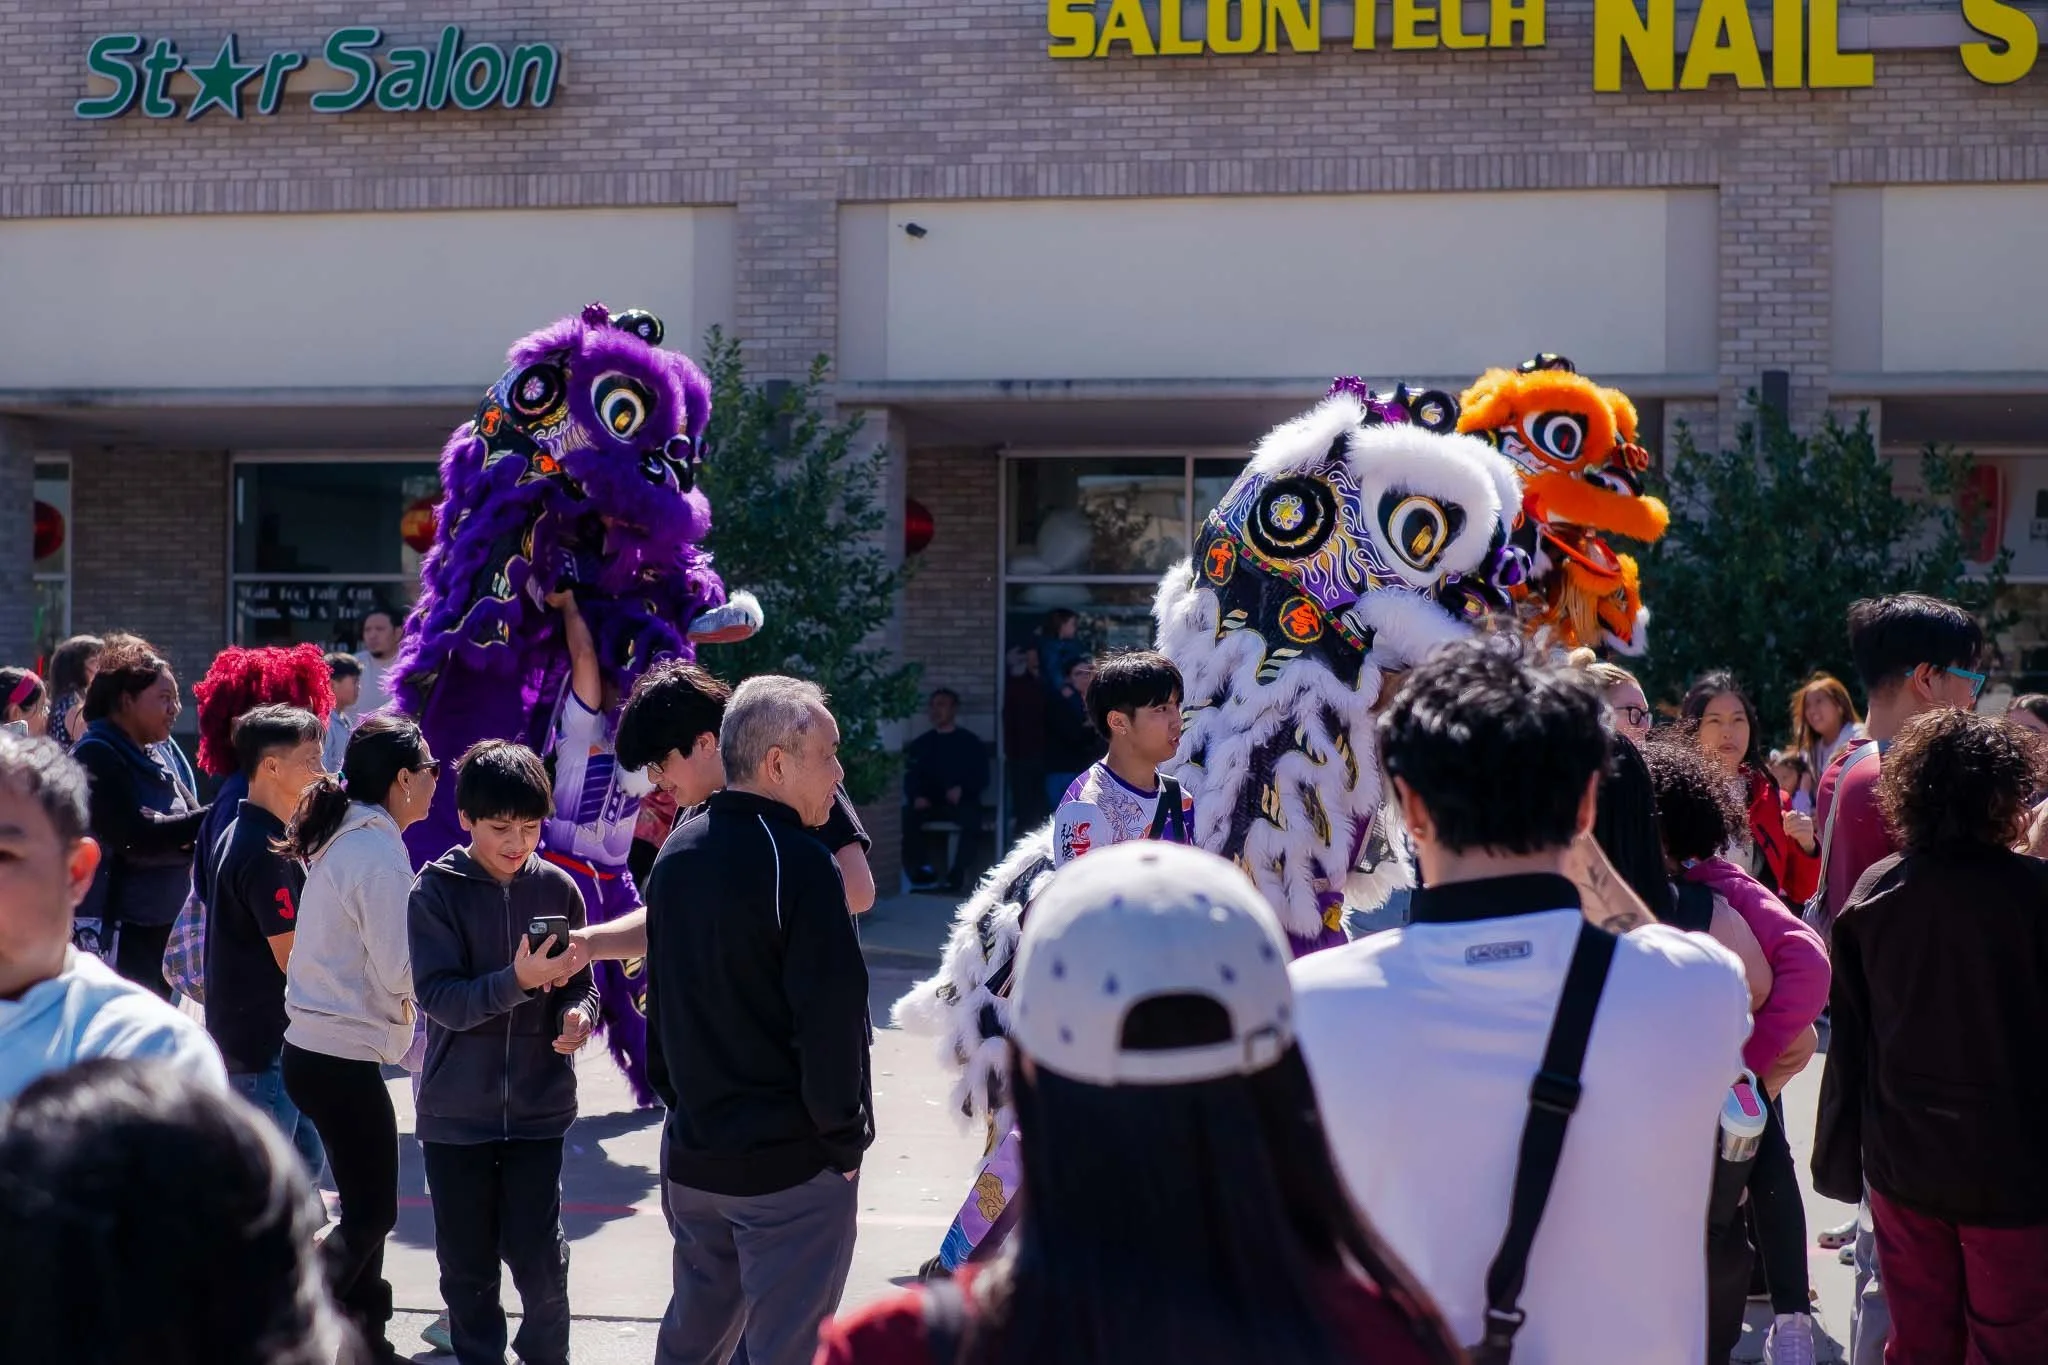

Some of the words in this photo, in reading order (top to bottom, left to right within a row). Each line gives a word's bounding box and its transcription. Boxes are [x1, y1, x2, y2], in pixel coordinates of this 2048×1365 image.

[1047, 0, 1321, 58] SALON
[1593, 0, 1875, 91] NAIL
[310, 24, 558, 112] Salon
[275, 888, 295, 919] 3
